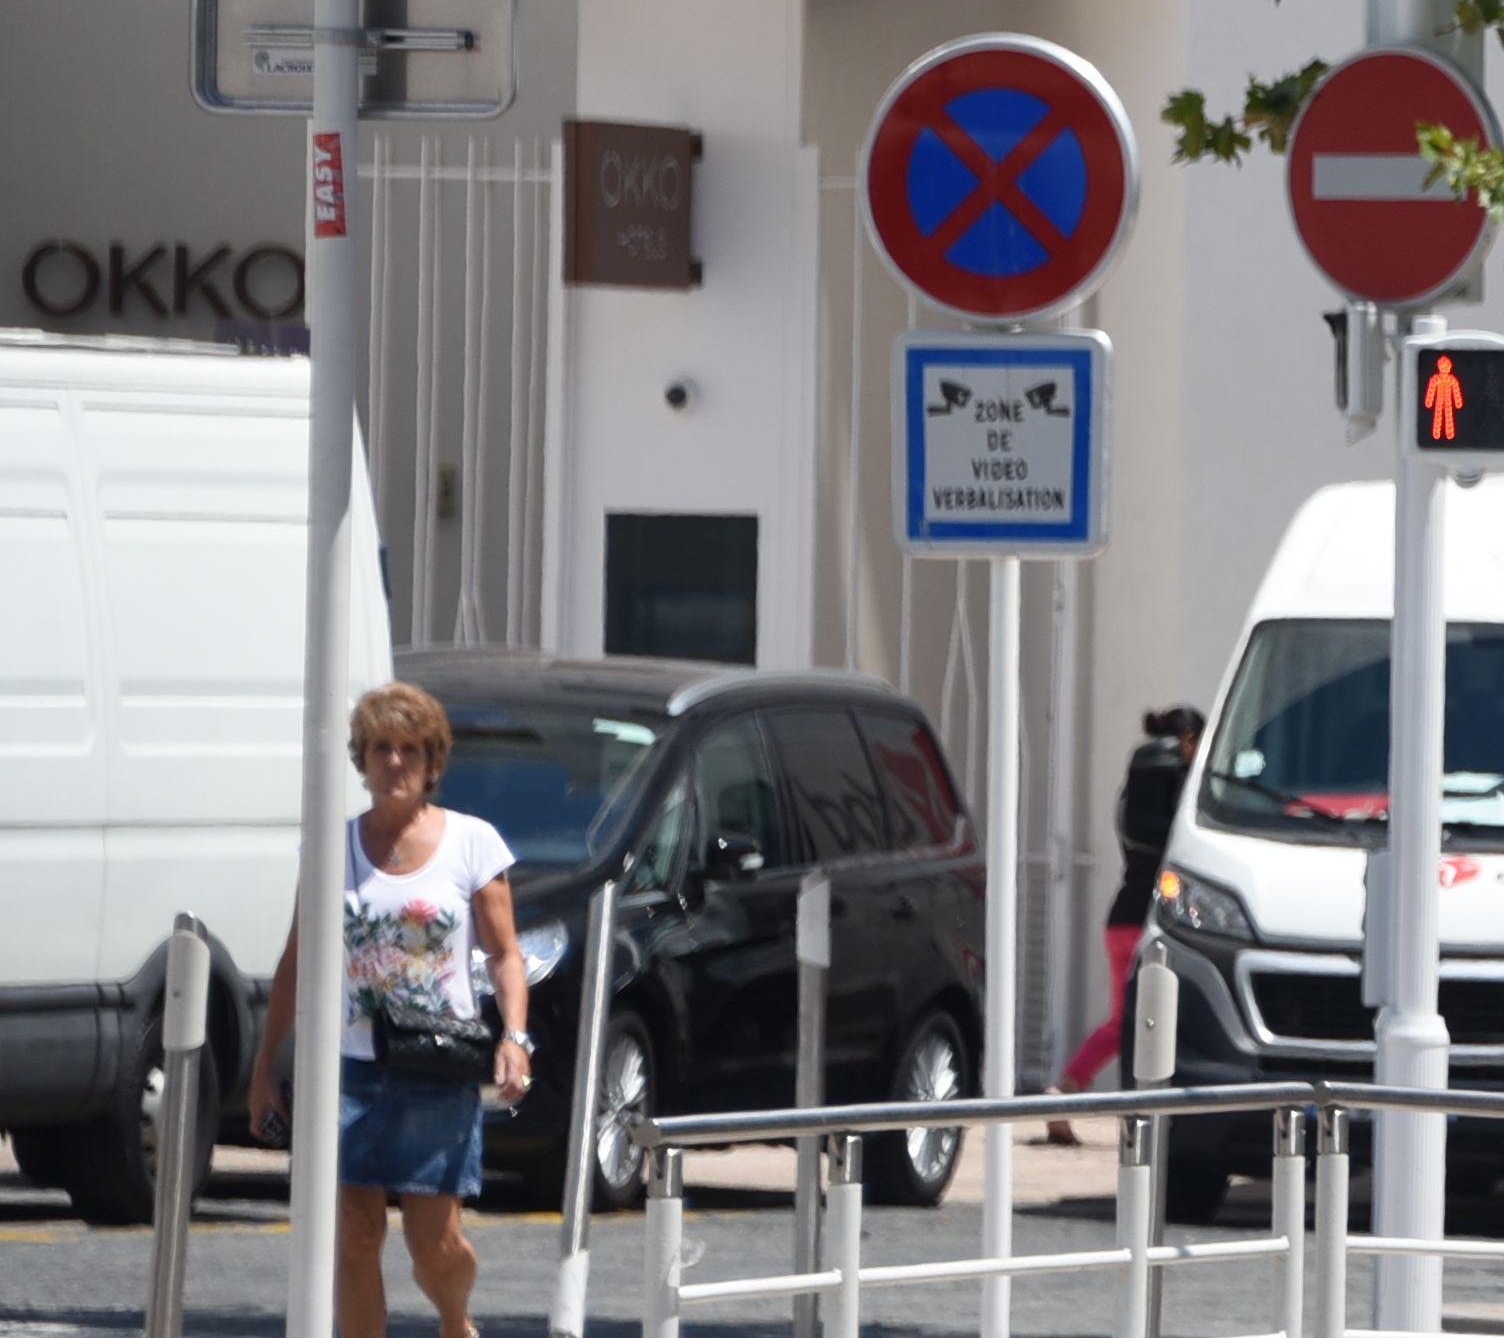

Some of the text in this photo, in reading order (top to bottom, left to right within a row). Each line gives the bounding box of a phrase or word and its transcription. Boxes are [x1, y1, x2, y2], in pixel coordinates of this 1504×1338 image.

[315, 145, 336, 222] EASY
[22, 236, 306, 319] OKKO
[974, 399, 1025, 423] ZONE
[986, 429, 1013, 452] DE
[971, 458, 1029, 481] VIDEO
[932, 487, 1066, 510] VERBALISATION
